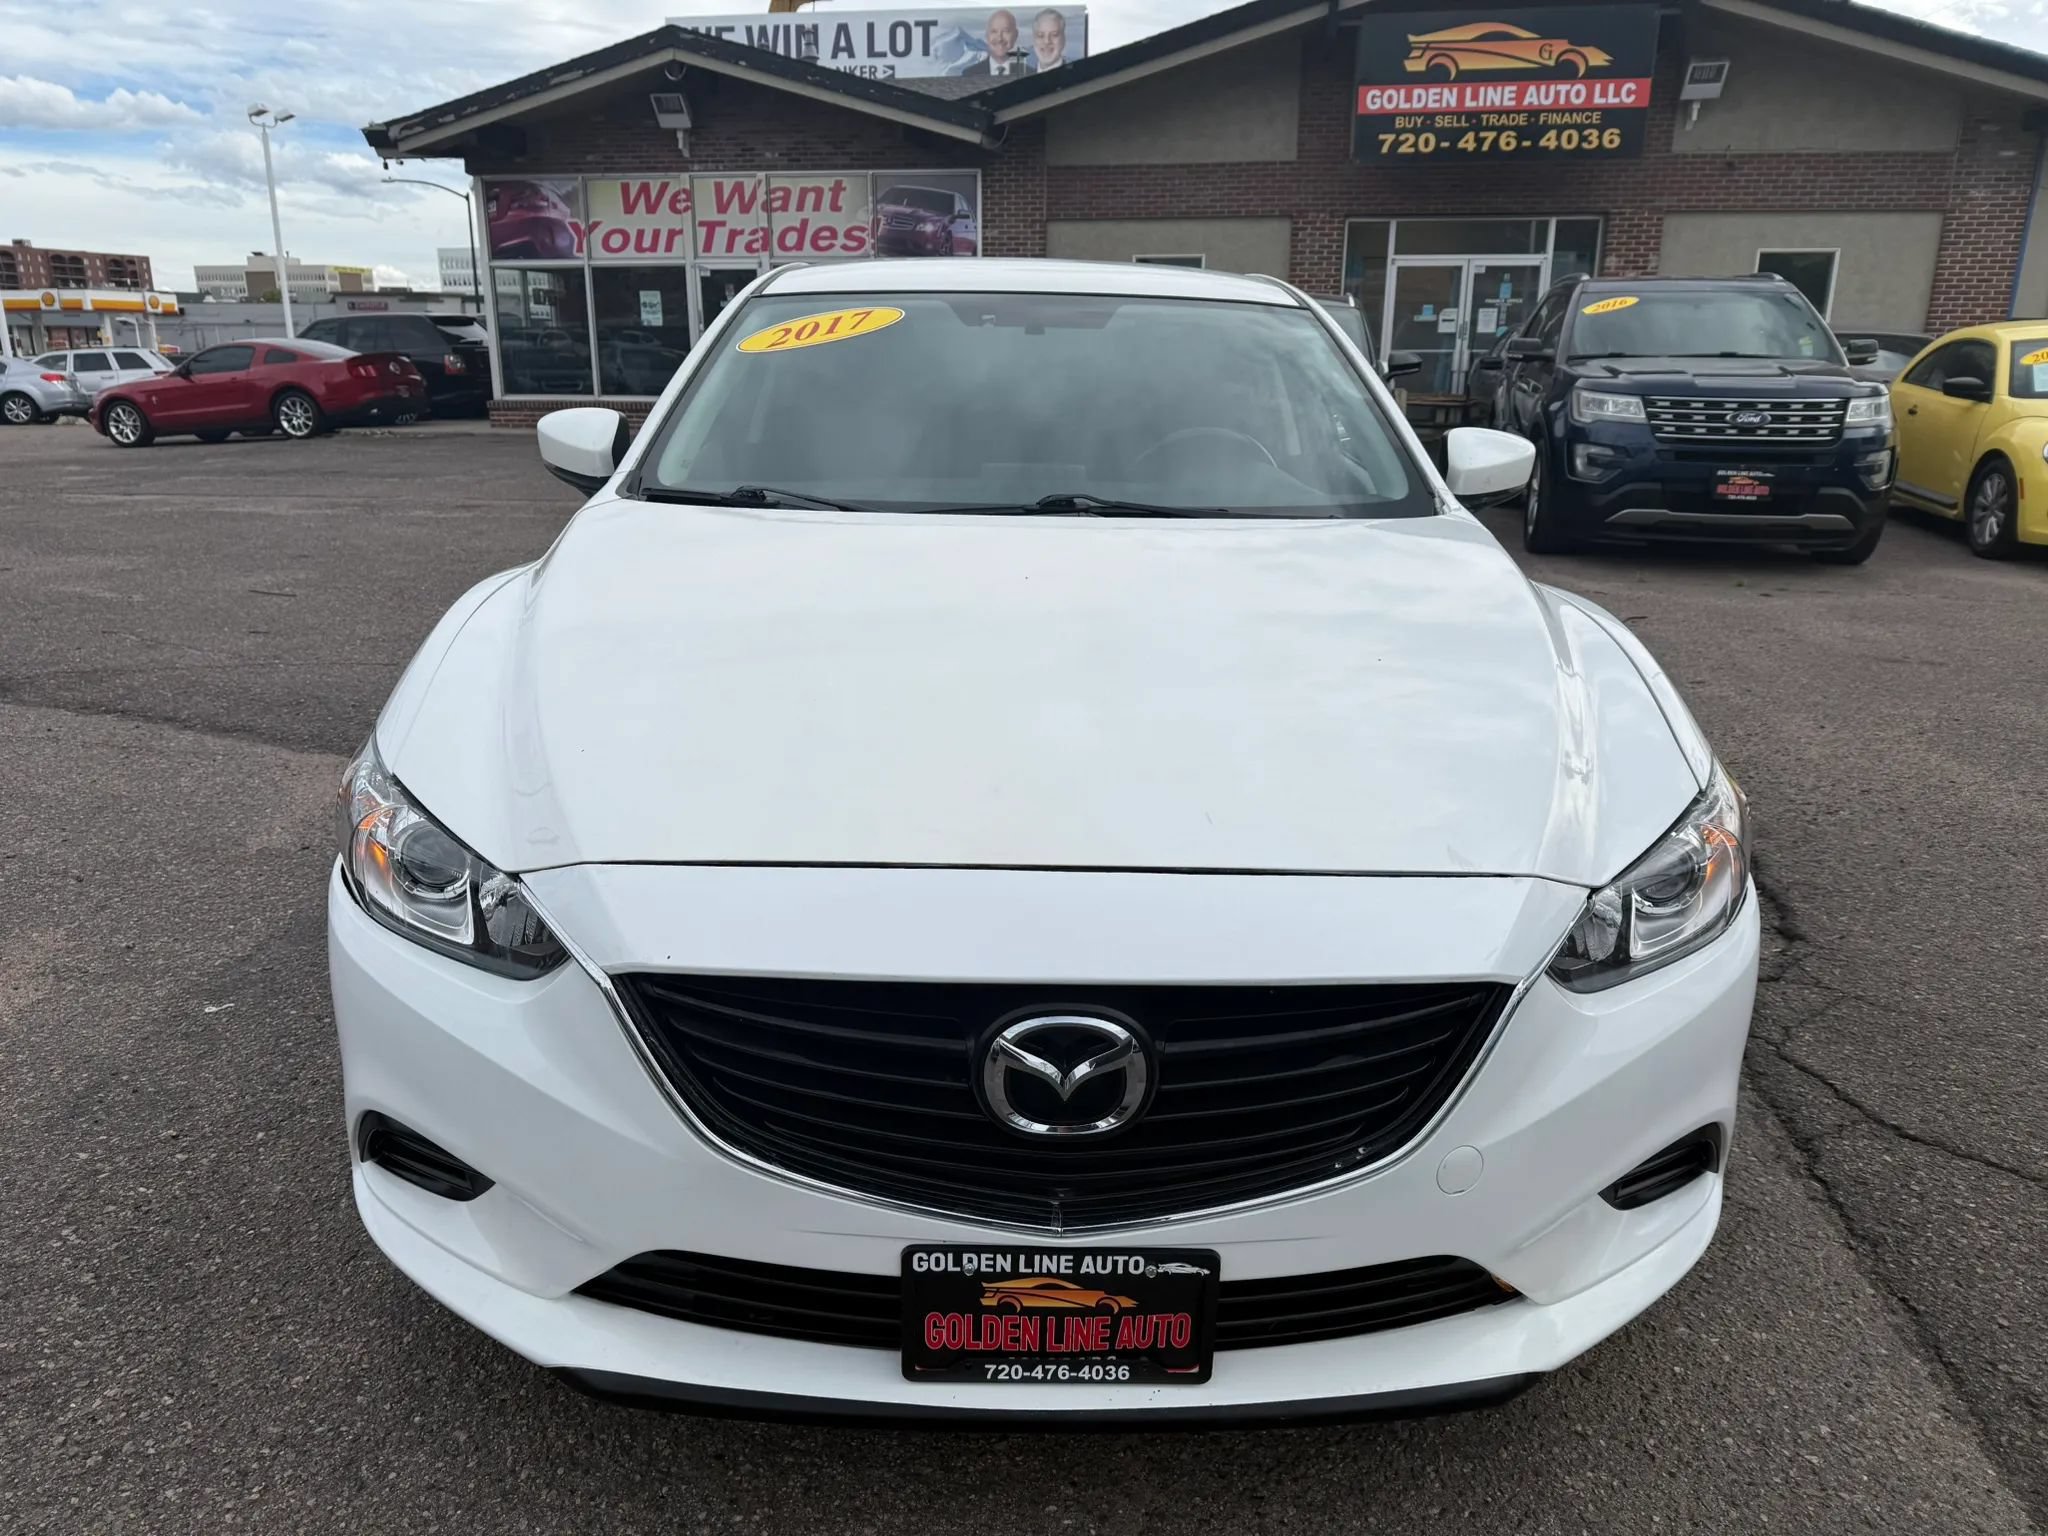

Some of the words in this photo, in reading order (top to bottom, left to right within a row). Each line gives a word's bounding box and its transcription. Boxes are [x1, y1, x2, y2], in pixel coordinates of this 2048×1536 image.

[831, 22, 856, 60] A
[866, 19, 938, 58] LOT
[1366, 87, 1458, 110] GOLDEN
[1463, 85, 1518, 107] LINE
[1523, 83, 1587, 106] AUTO
[1593, 82, 1637, 104] LLC
[1395, 116, 1424, 129] BUY
[1435, 114, 1470, 128] SELL
[1481, 113, 1528, 127] TRADE
[1538, 111, 1602, 125] FINANCE
[619, 180, 693, 215] We
[713, 178, 847, 215] Want
[568, 219, 685, 255] Your
[766, 310, 875, 350] 2017
[1736, 413, 1762, 423] Ford
[912, 1251, 1012, 1274] GOLDEN
[1019, 1253, 1073, 1275] LINE
[1079, 1254, 1146, 1276] AUTO
[924, 1311, 1040, 1352] GOLDEN
[1046, 1315, 1111, 1353] LINE
[1114, 1312, 1193, 1350] AUTO
[984, 1364, 1131, 1381] 720-476-4036
